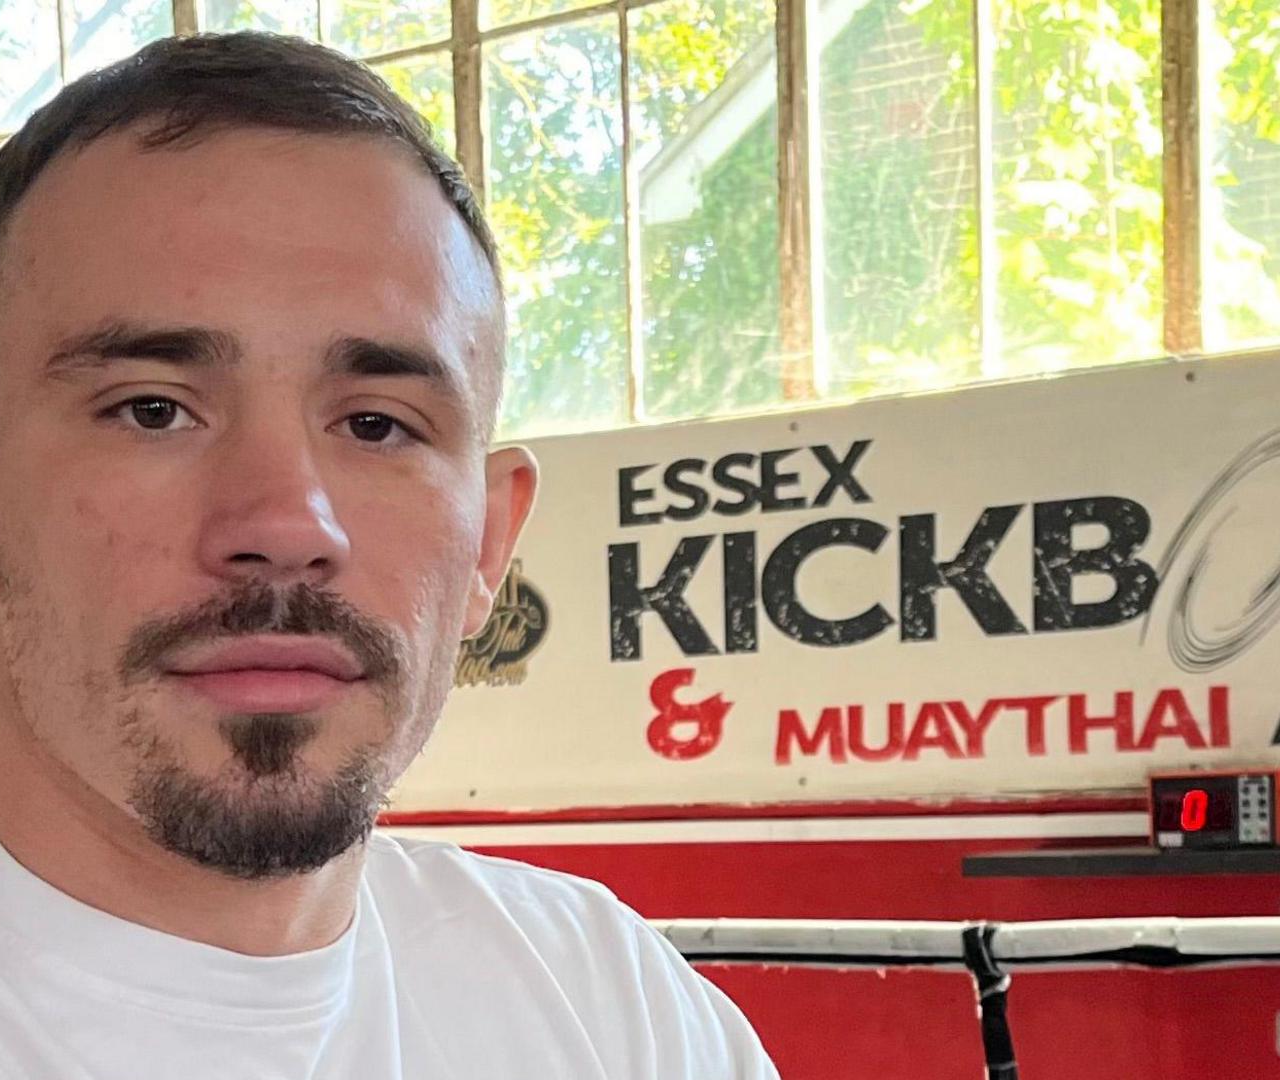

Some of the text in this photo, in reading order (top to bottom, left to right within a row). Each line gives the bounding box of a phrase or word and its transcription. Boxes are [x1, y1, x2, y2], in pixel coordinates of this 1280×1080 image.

[617, 438, 873, 527] ESSEX
[645, 667, 732, 761] &
[773, 685, 1232, 766] MUAYTHAI
[1180, 788, 1209, 832] 0
